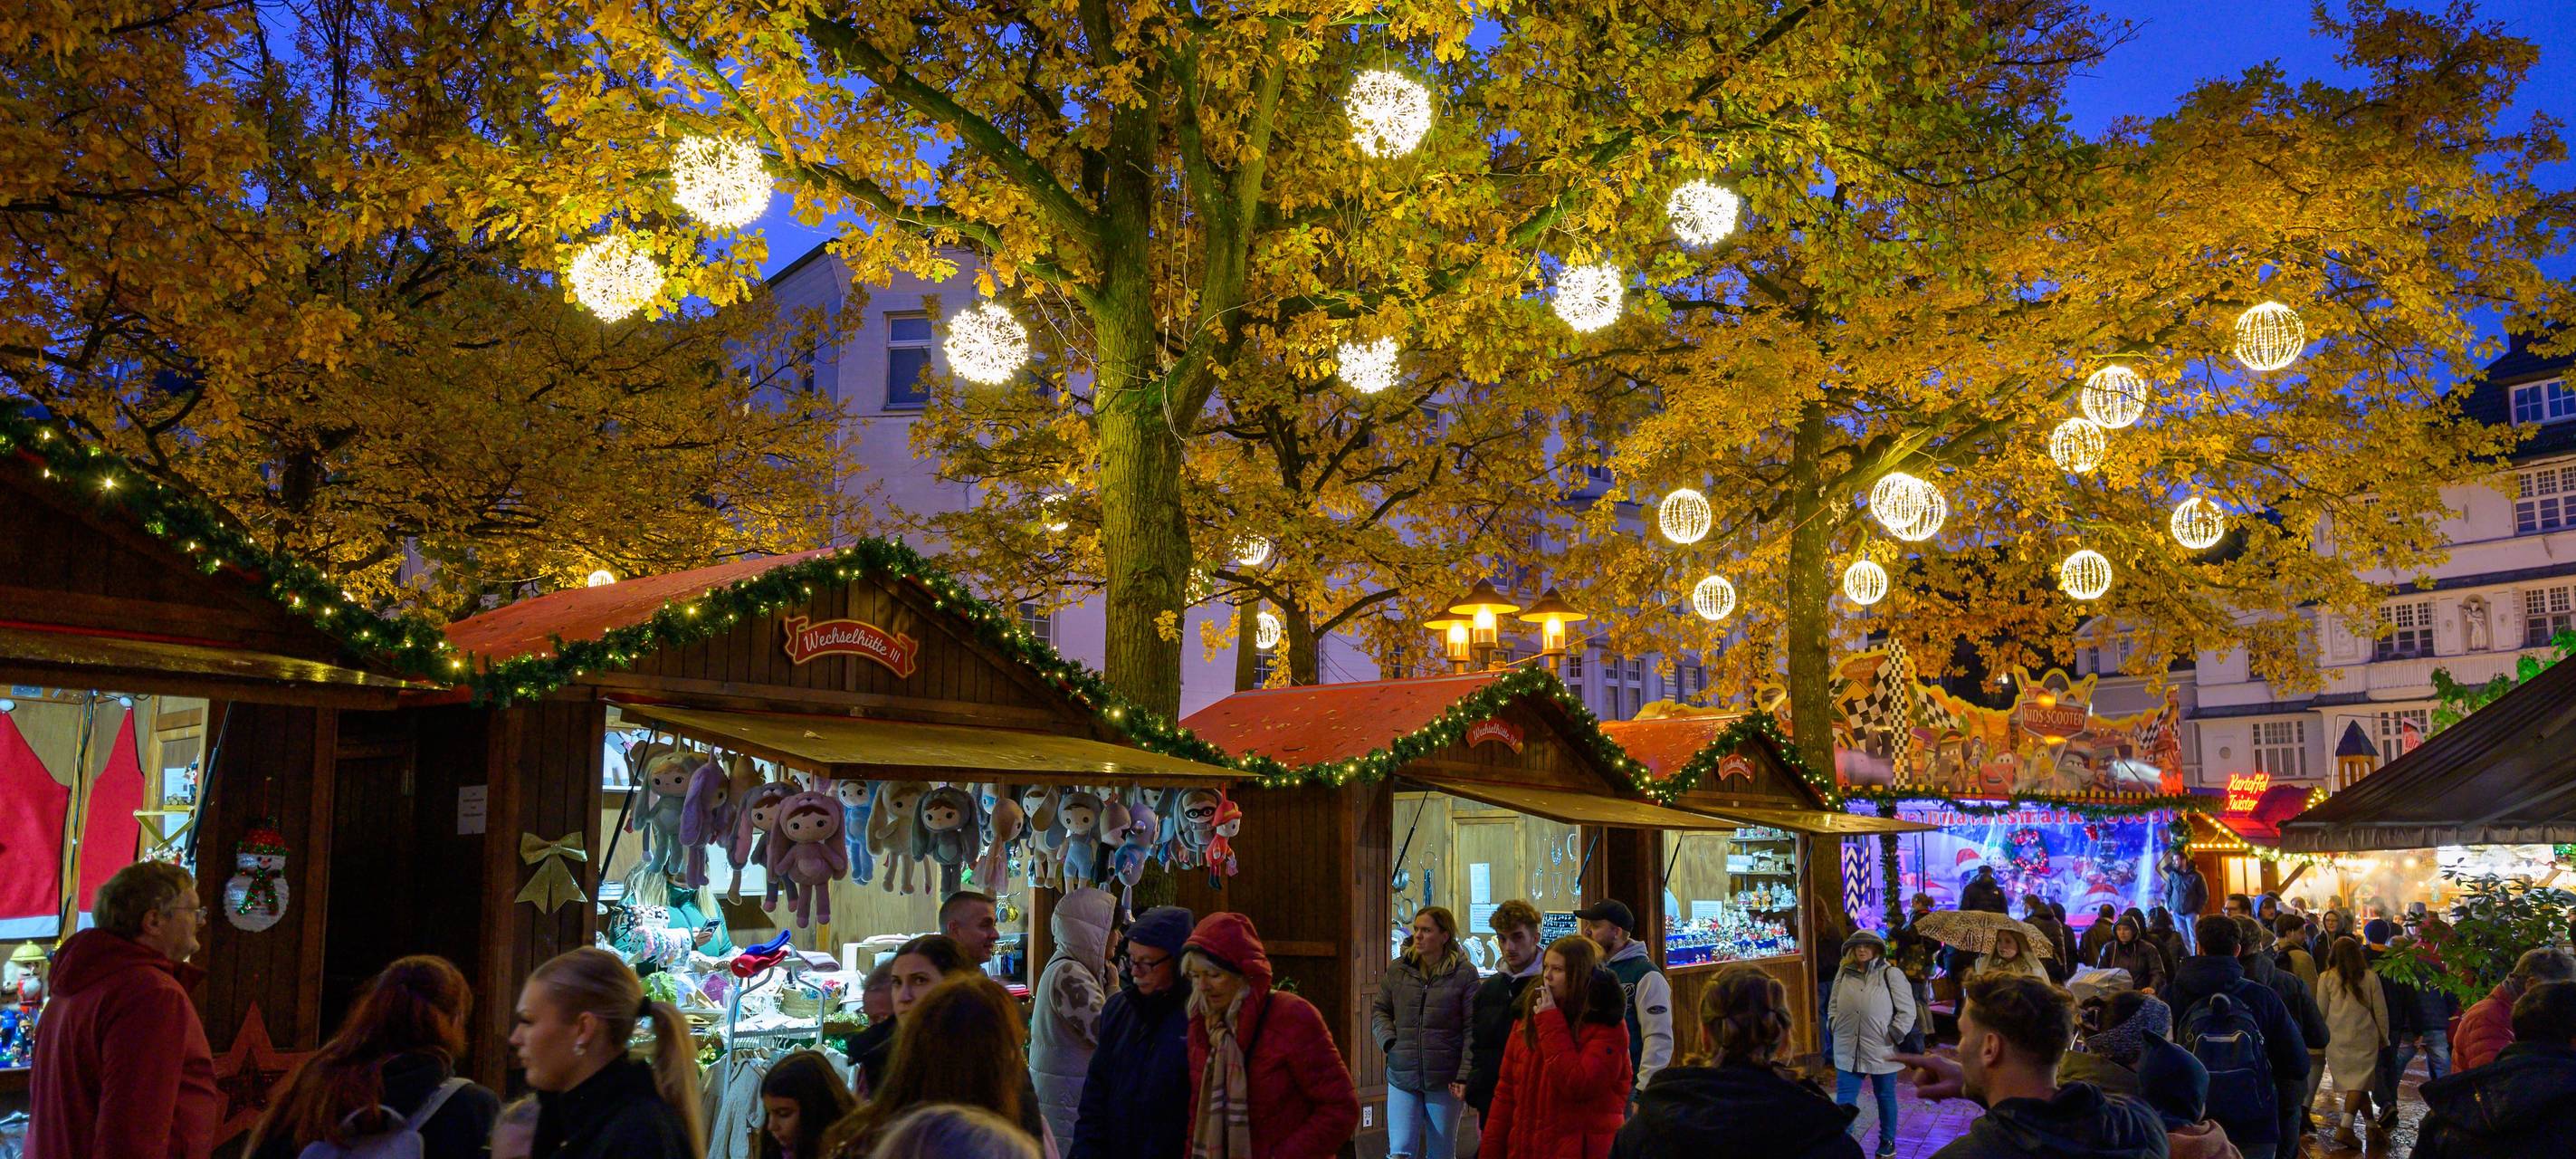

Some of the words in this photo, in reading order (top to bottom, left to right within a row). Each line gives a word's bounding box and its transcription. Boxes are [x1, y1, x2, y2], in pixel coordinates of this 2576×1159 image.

[804, 627, 887, 656] Wechselhütte
[2228, 773, 2270, 794] Kartoffel
[2226, 794, 2258, 811] Twister
